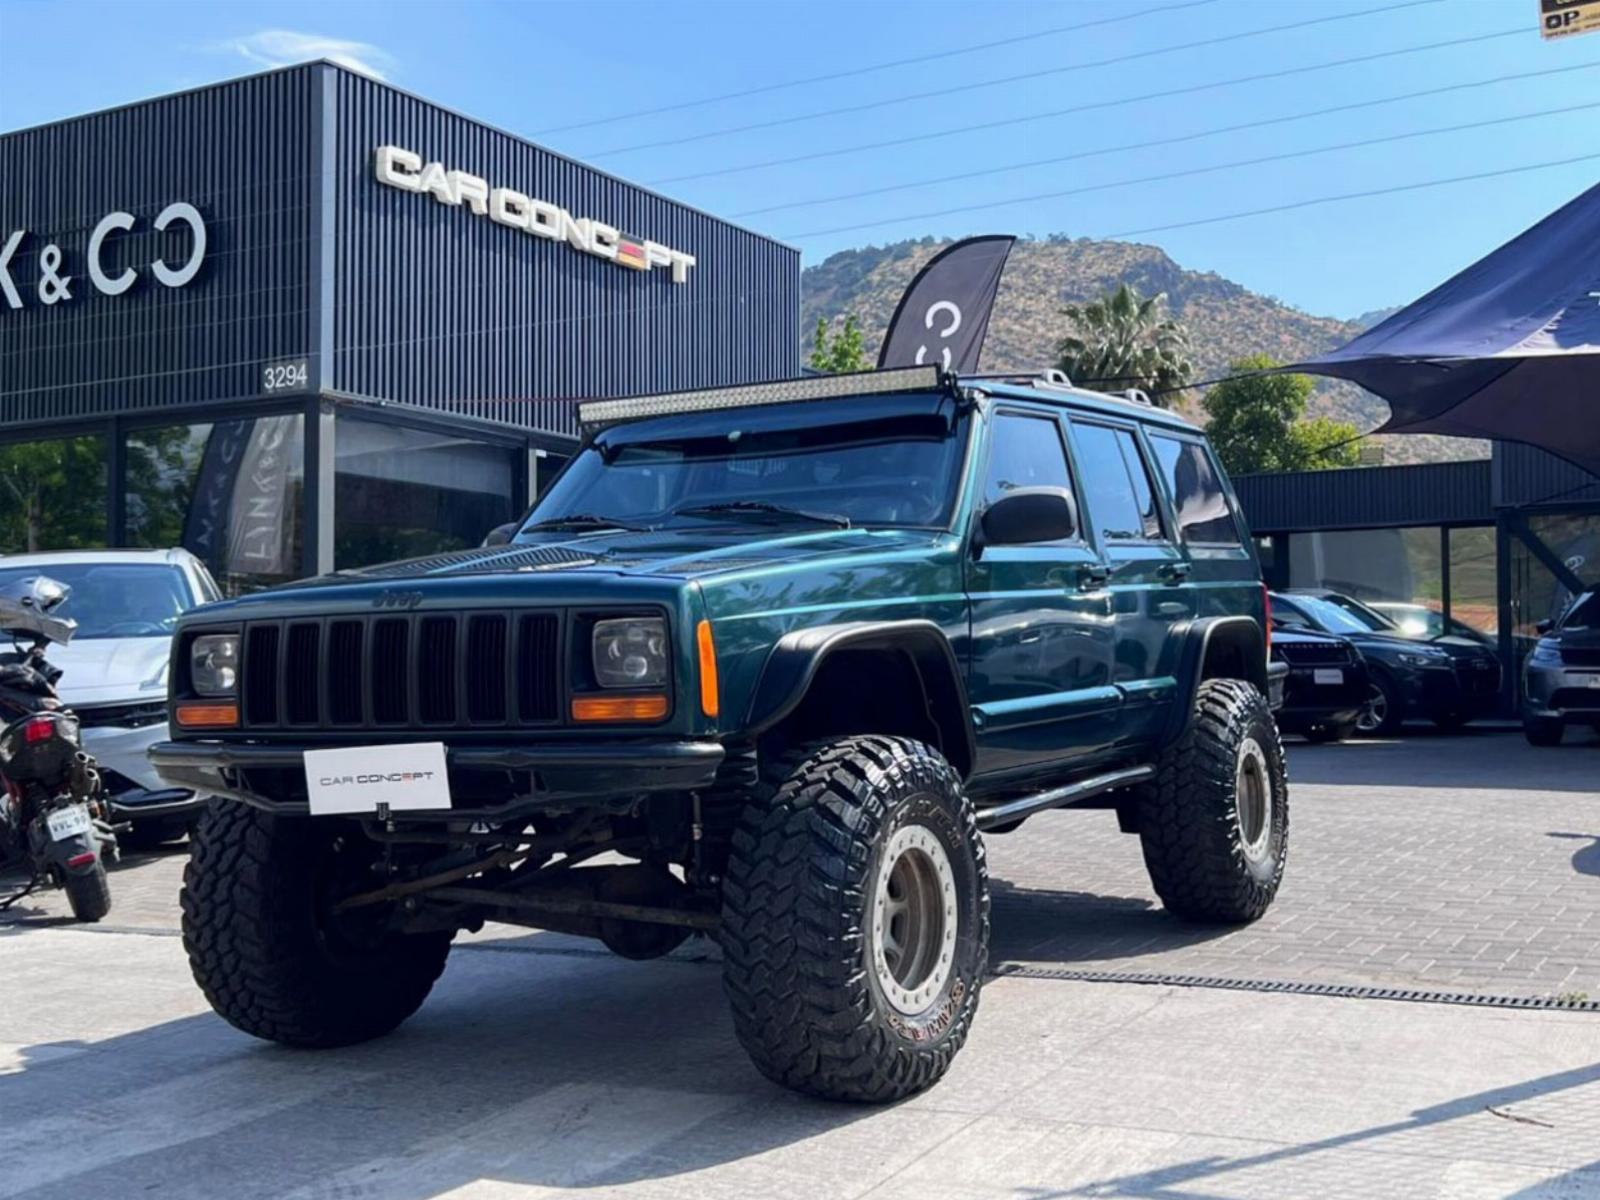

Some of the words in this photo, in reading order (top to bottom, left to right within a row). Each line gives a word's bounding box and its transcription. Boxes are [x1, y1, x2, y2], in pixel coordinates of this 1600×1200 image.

[375, 144, 488, 215] CAR
[264, 363, 308, 389] 3294
[320, 777, 354, 786] CAR
